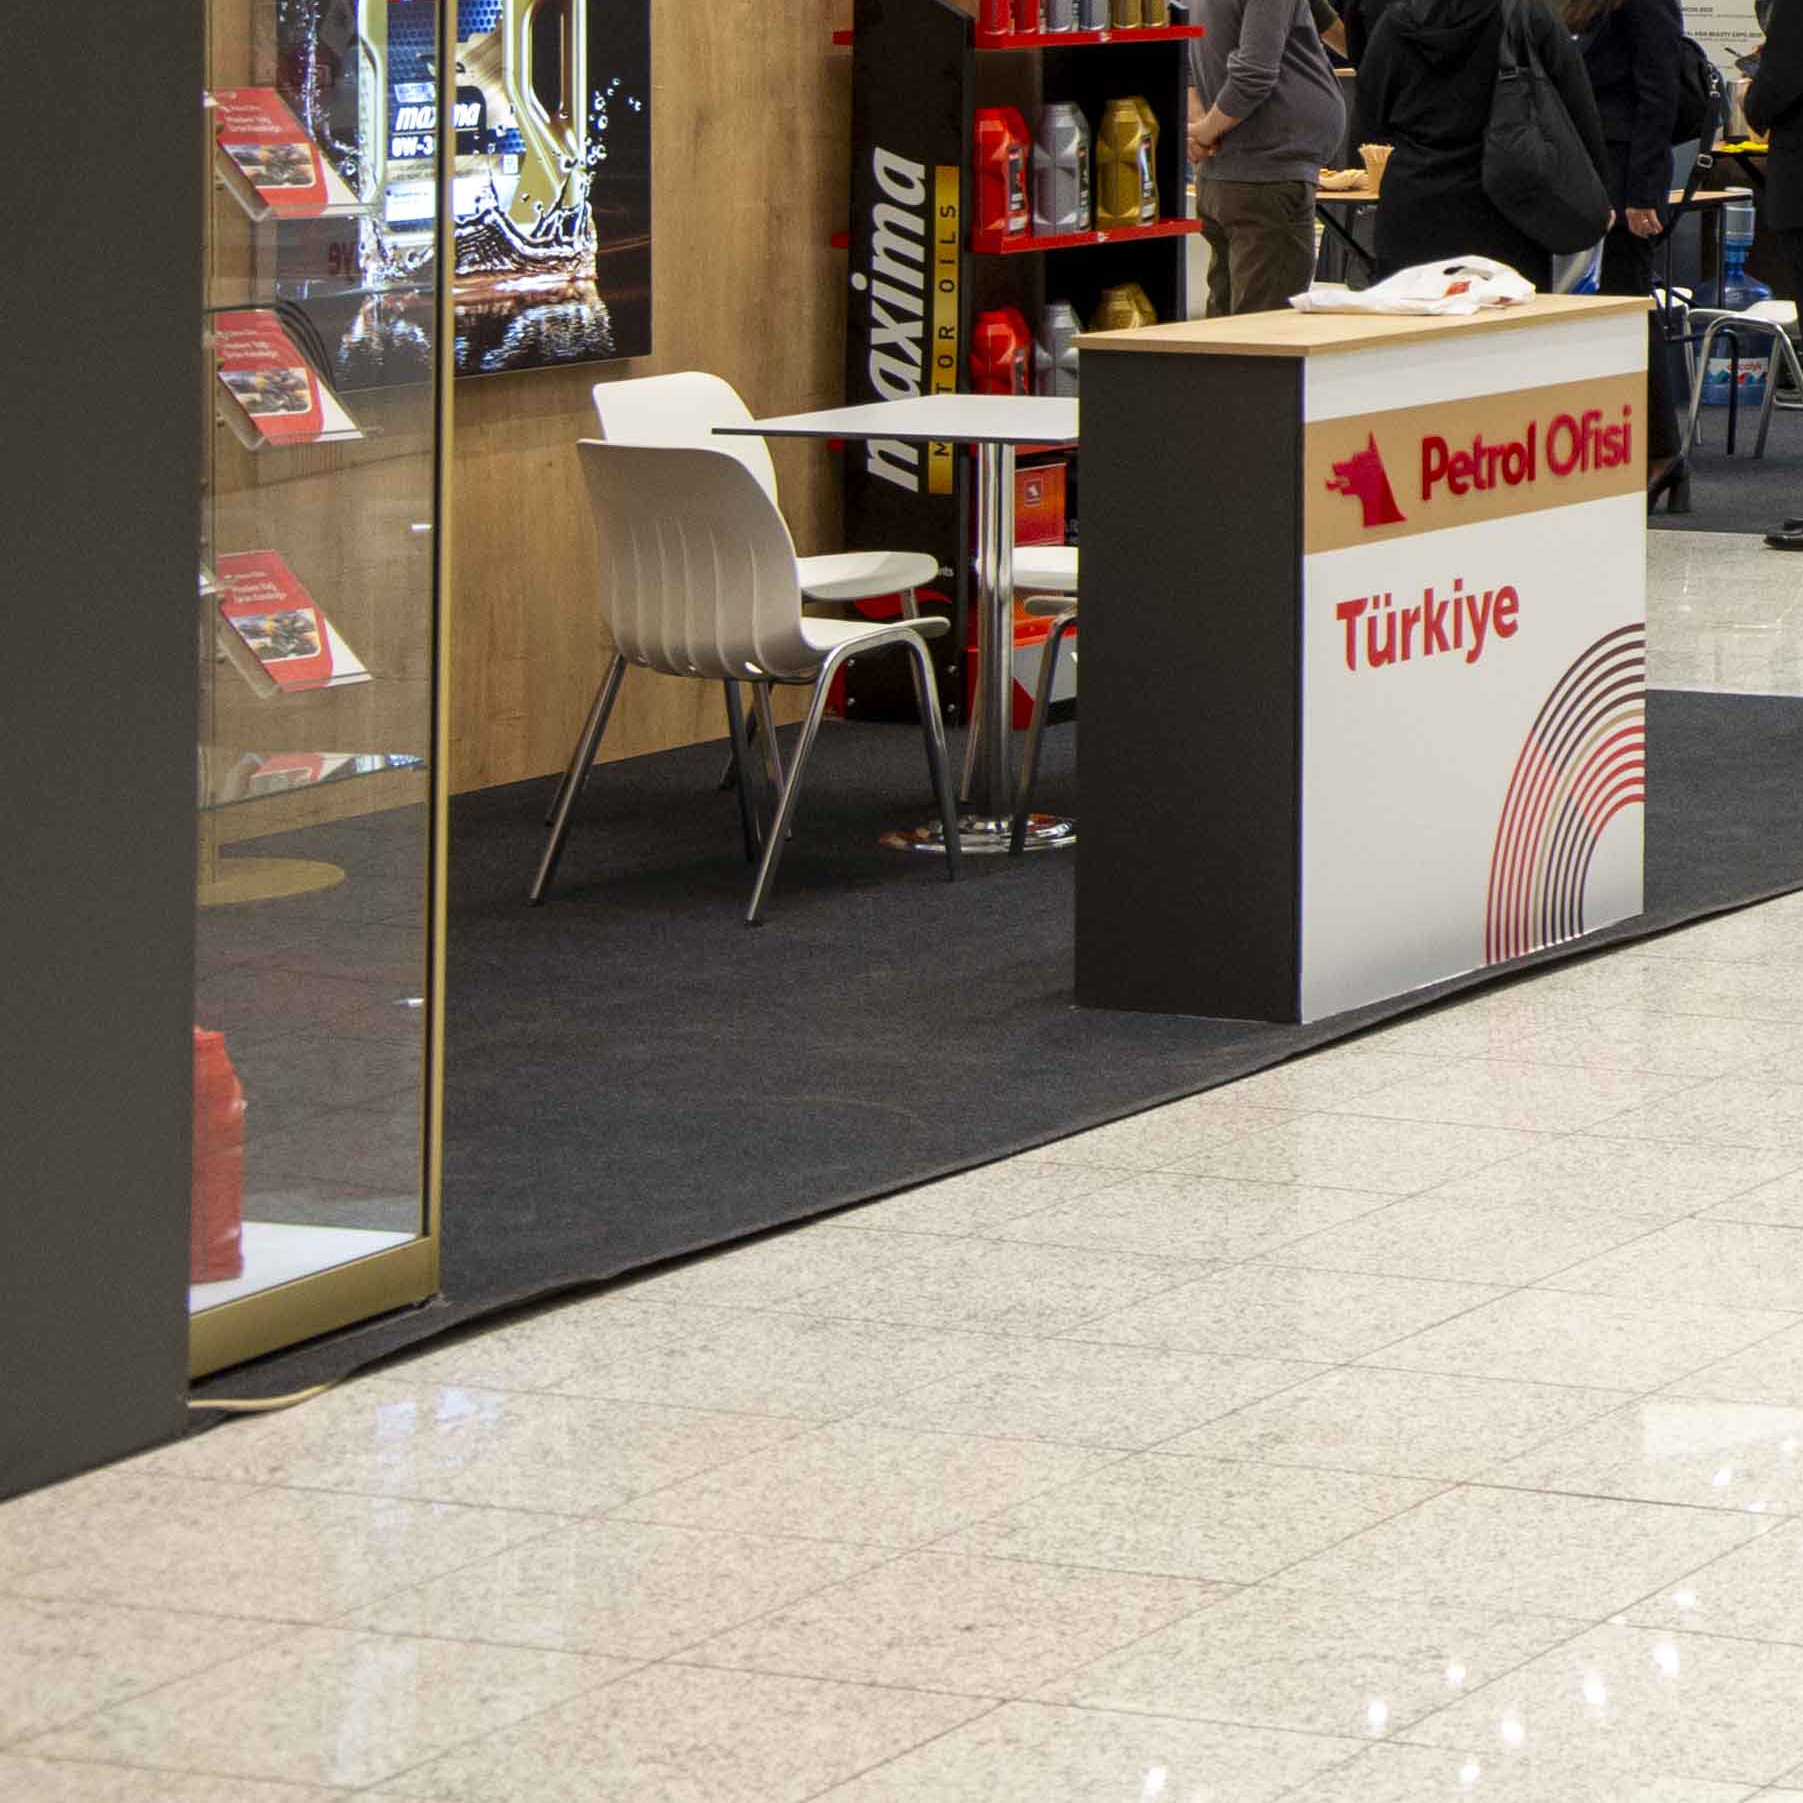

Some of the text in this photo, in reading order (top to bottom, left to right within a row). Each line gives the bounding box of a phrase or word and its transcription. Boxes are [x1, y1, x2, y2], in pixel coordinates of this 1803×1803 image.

[933, 203, 957, 457] MTOR OILS
[1421, 403, 1632, 502] Petrol Ofisi
[1335, 577, 1520, 672] Türkiye
